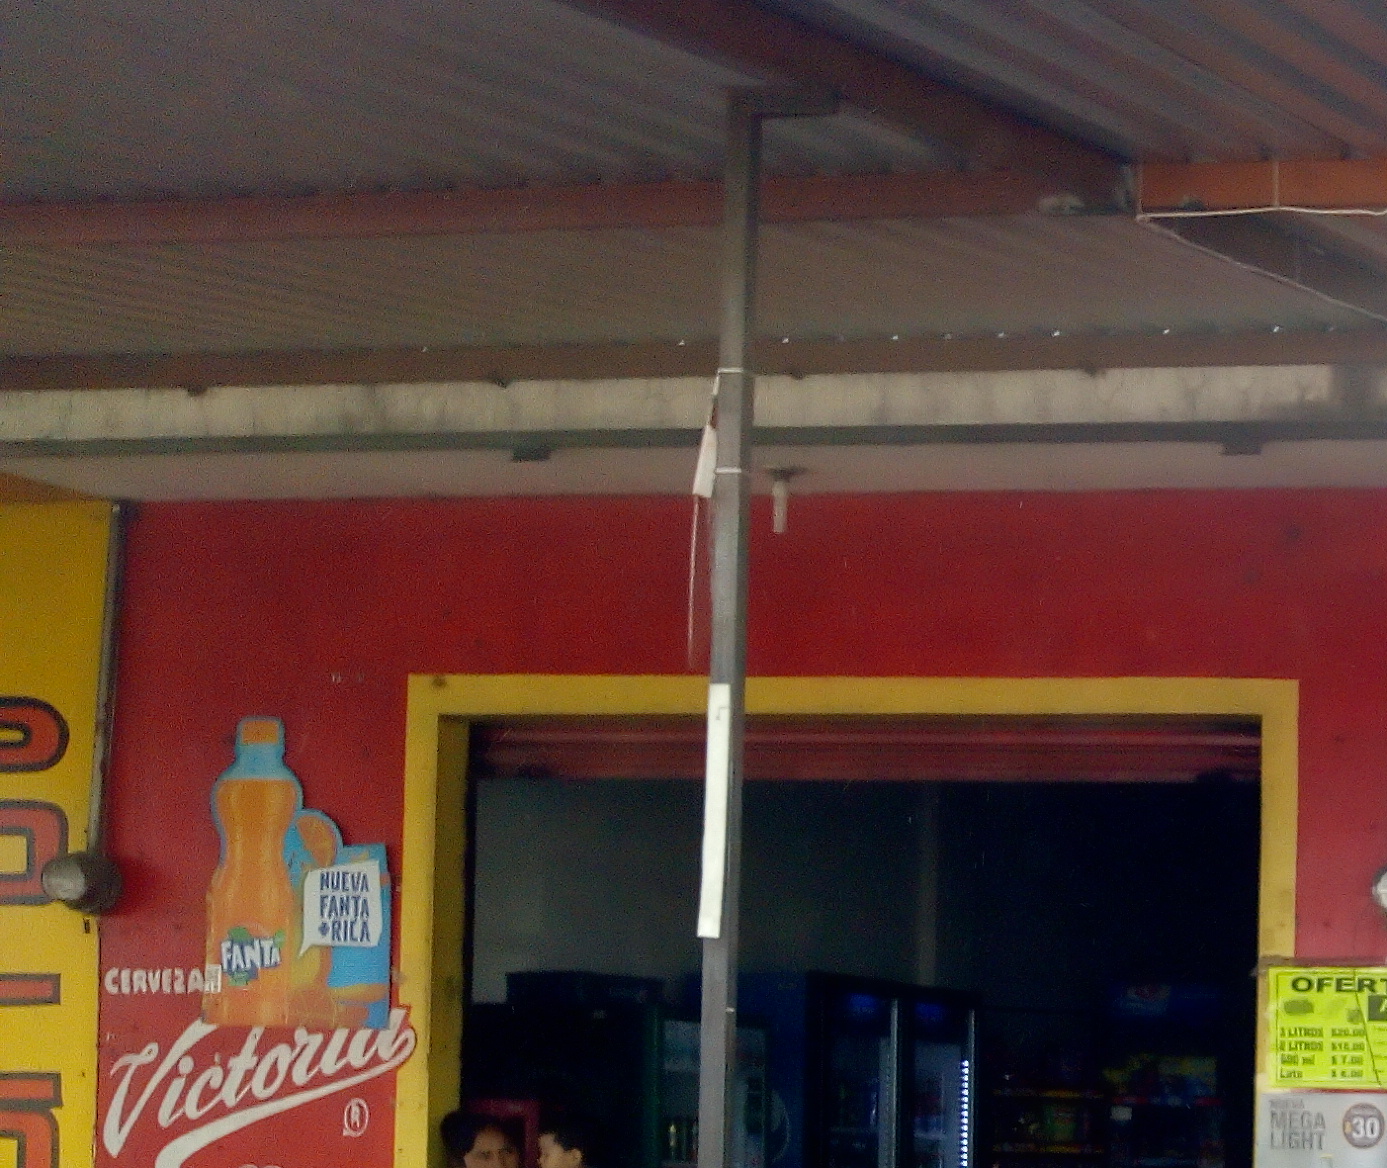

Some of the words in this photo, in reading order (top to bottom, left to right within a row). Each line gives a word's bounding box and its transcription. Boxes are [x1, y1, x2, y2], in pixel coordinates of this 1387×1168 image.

[319, 871, 370, 893] NUEVA
[319, 896, 370, 919] FANTA
[220, 936, 282, 973] FANTA
[98, 1007, 417, 1160] Victoria
[1270, 1110, 1326, 1130] MEGA
[1270, 1130, 1324, 1151] LIGHT
